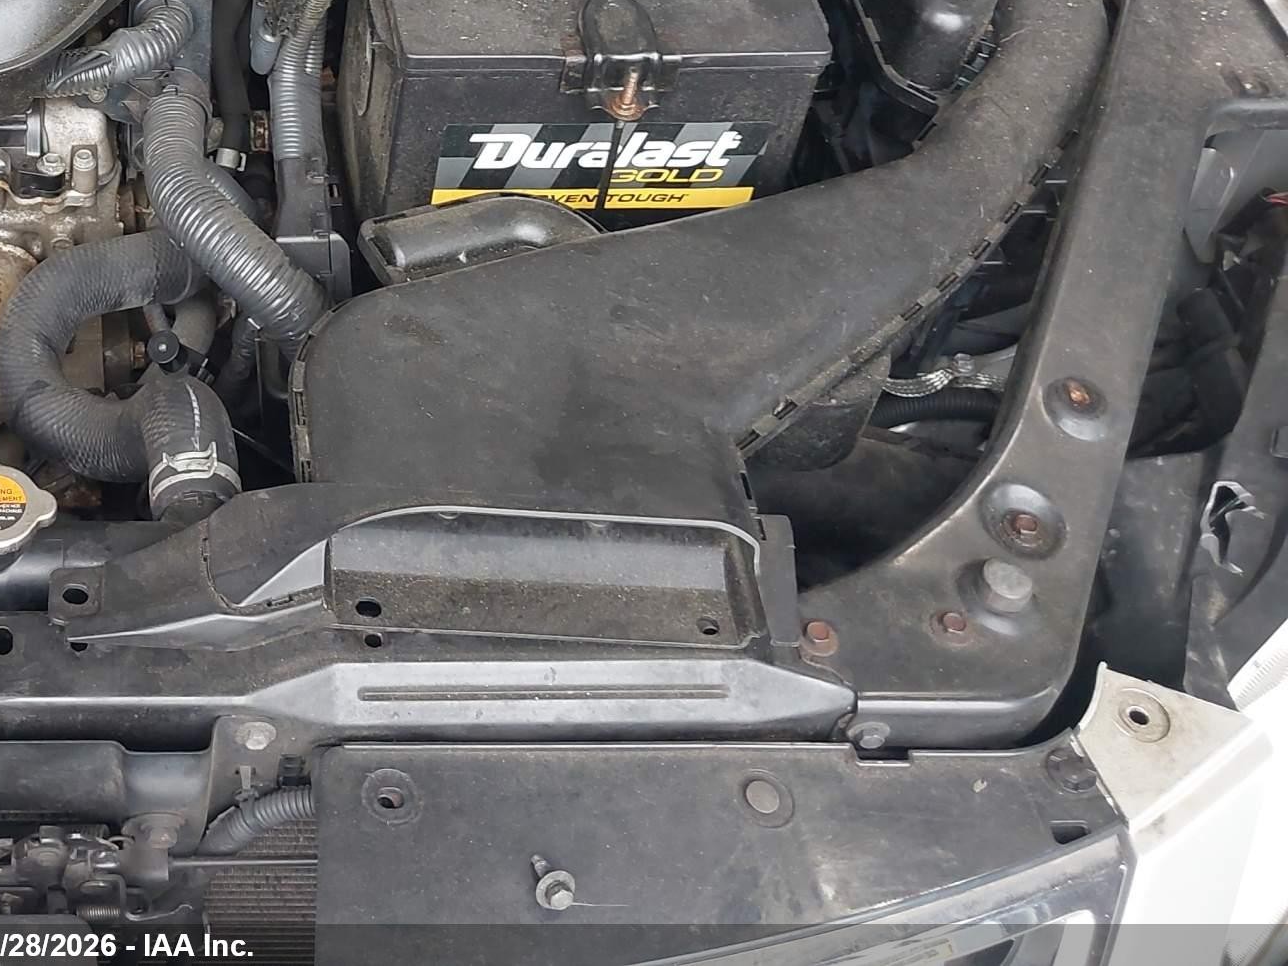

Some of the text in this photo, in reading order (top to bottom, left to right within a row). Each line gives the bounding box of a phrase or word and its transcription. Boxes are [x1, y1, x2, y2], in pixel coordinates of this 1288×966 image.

[469, 130, 743, 169] Duralast
[611, 168, 724, 183] GOLD
[606, 193, 685, 203] TOUGH
